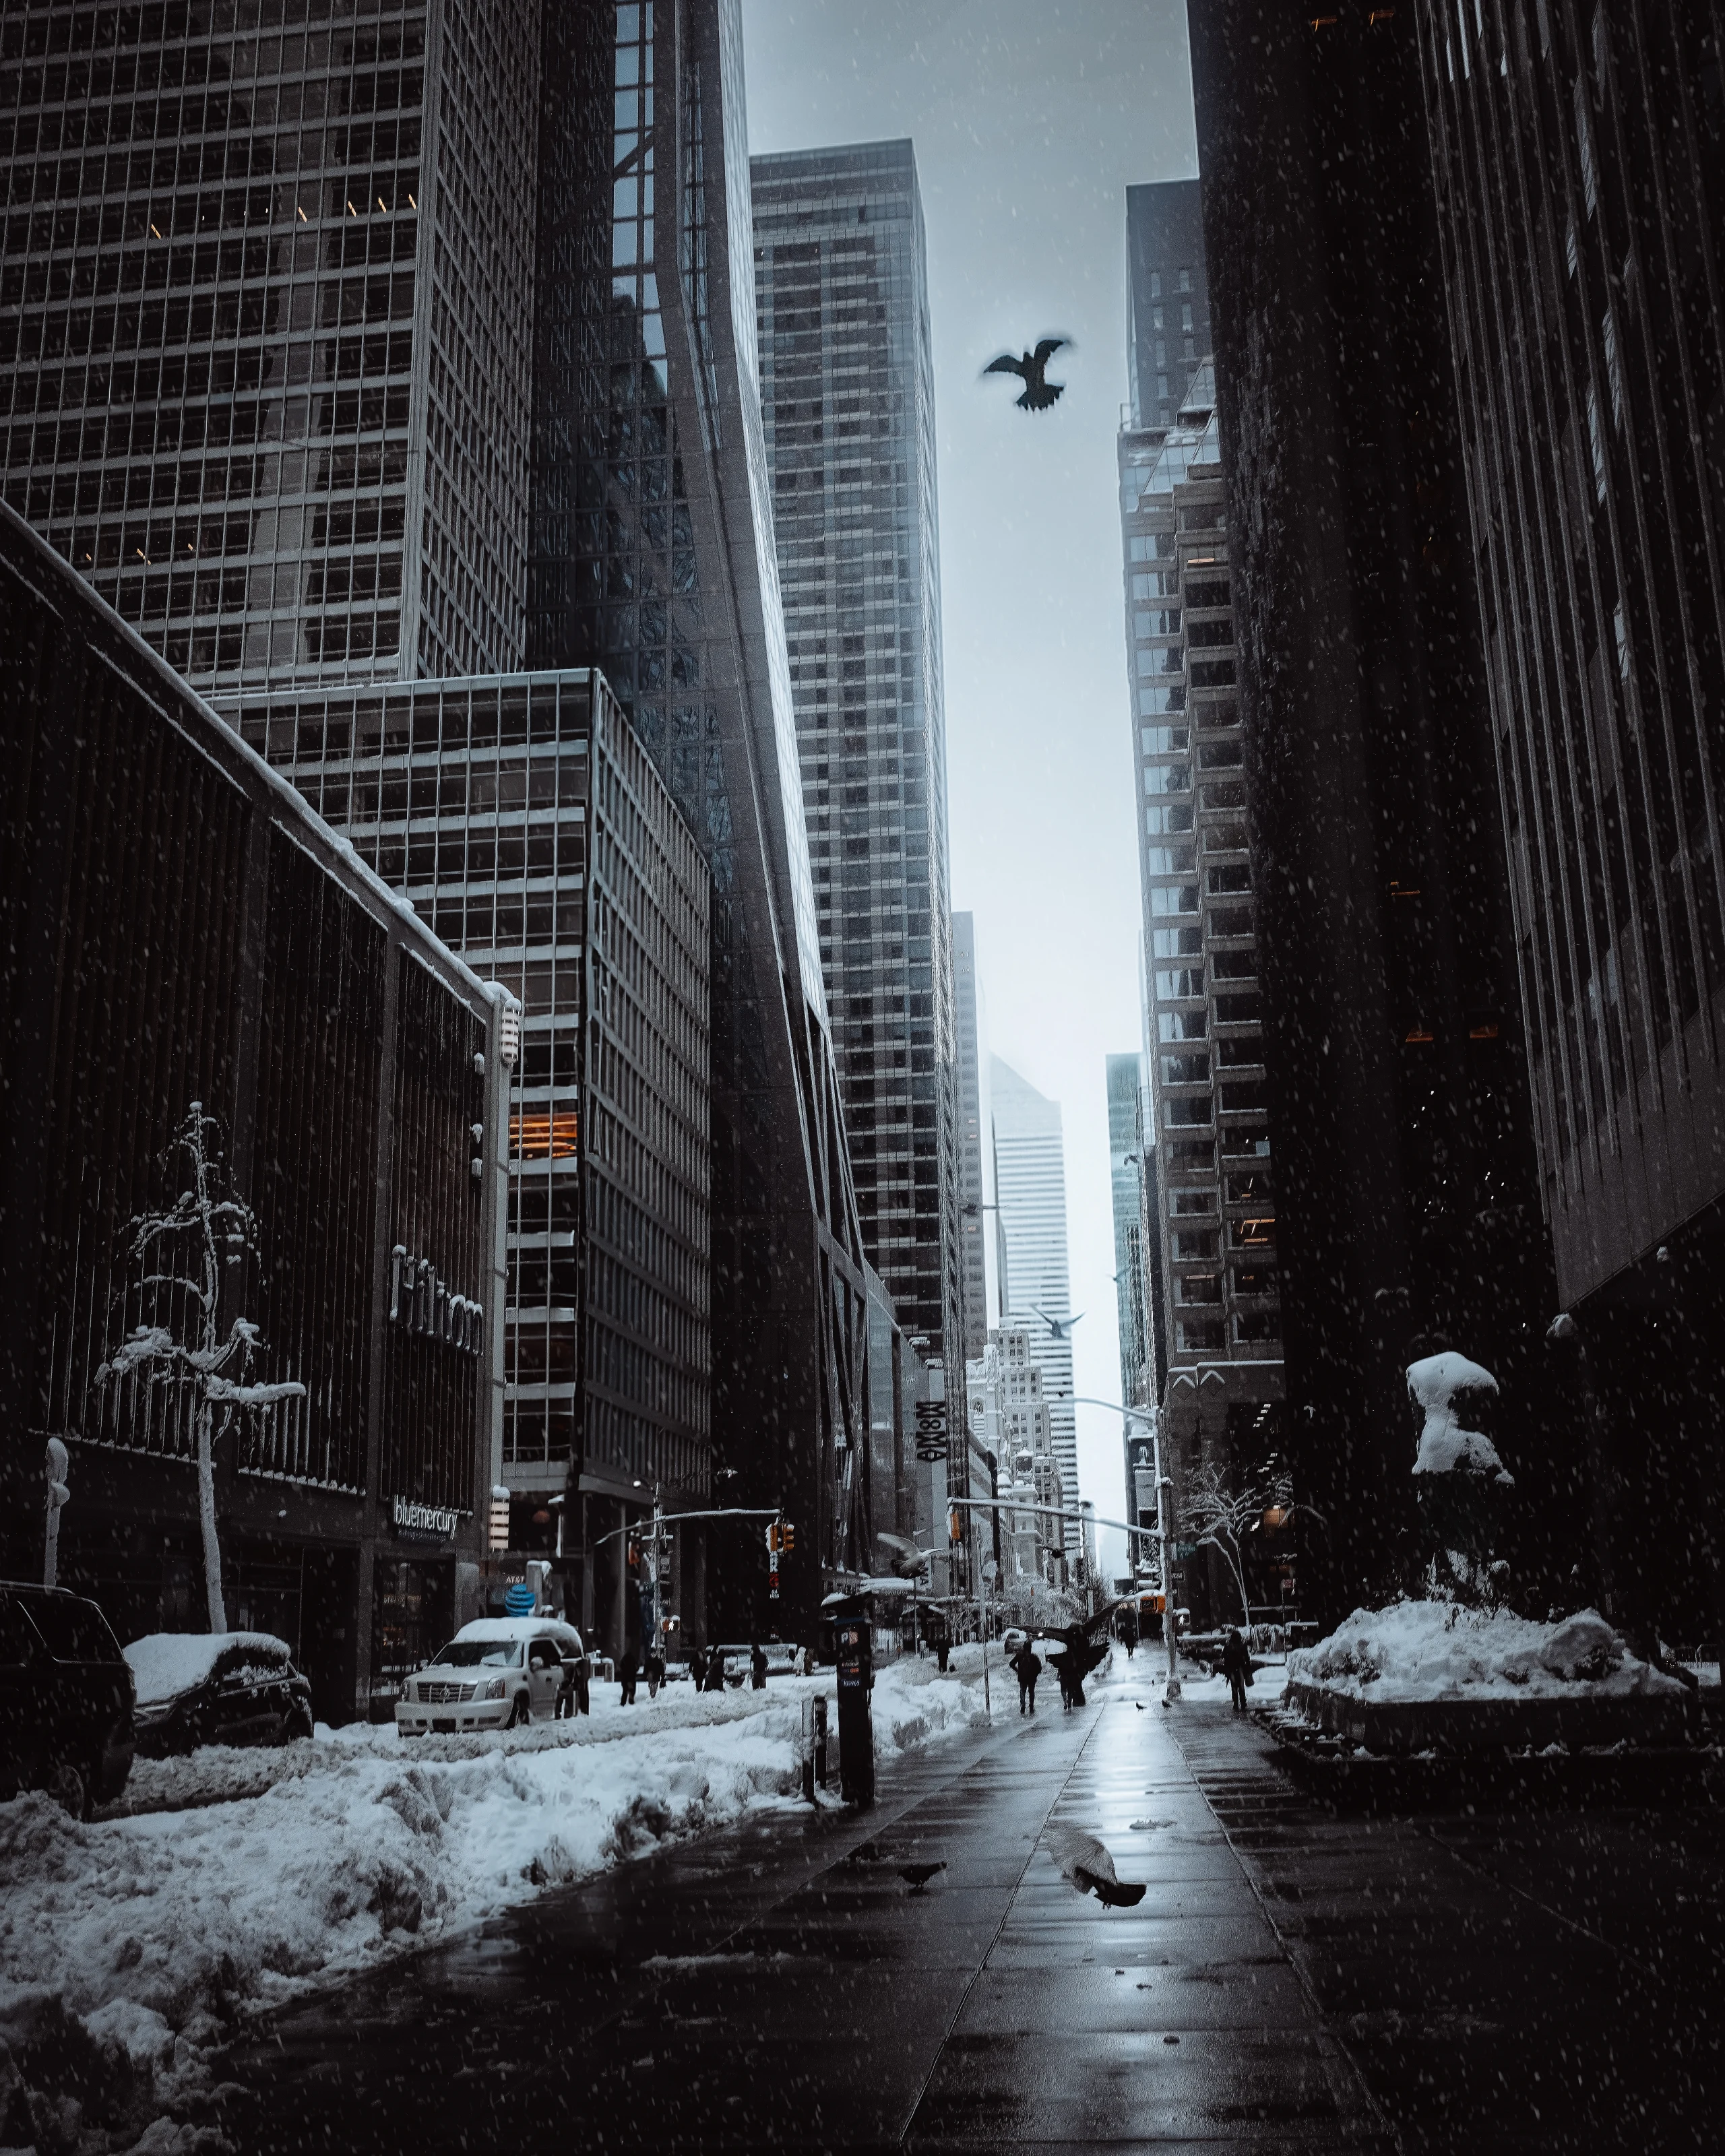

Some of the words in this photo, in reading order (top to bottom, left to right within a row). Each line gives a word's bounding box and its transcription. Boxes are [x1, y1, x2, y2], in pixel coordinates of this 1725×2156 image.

[389, 1248, 483, 1356] Hilton
[394, 1494, 458, 1540] bluemercury
[506, 1575, 525, 1584] AT&T
